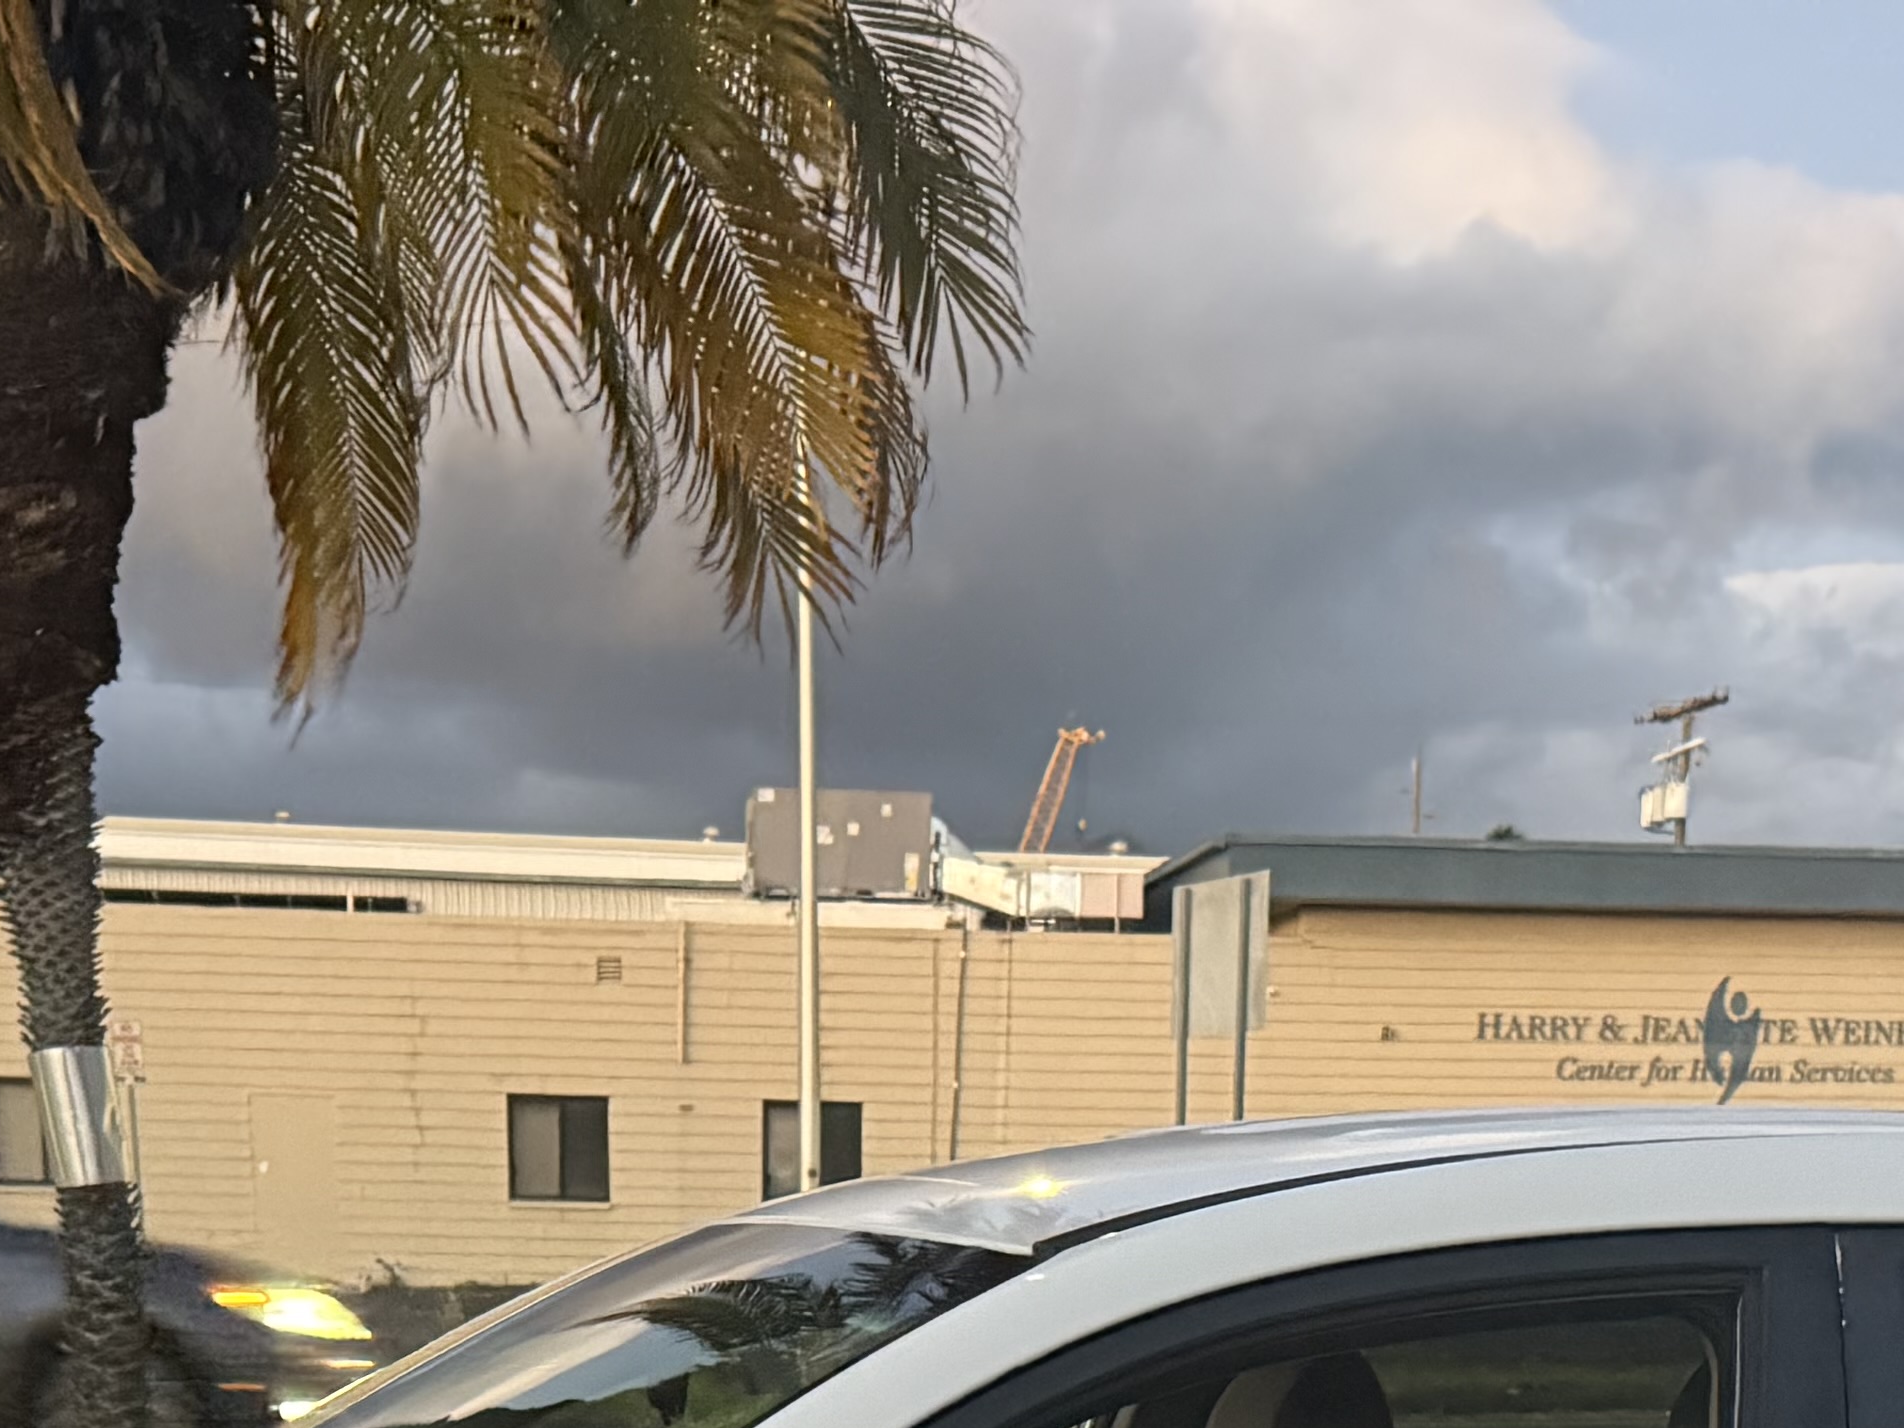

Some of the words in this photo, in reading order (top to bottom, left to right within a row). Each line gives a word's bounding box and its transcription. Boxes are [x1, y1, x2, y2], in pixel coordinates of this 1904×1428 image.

[1476, 1012, 1590, 1042] HARRY
[1598, 1014, 1626, 1043] &
[1556, 1056, 1640, 1082] Center
[1640, 1055, 1684, 1087] for
[1789, 1059, 1896, 1084] Services
